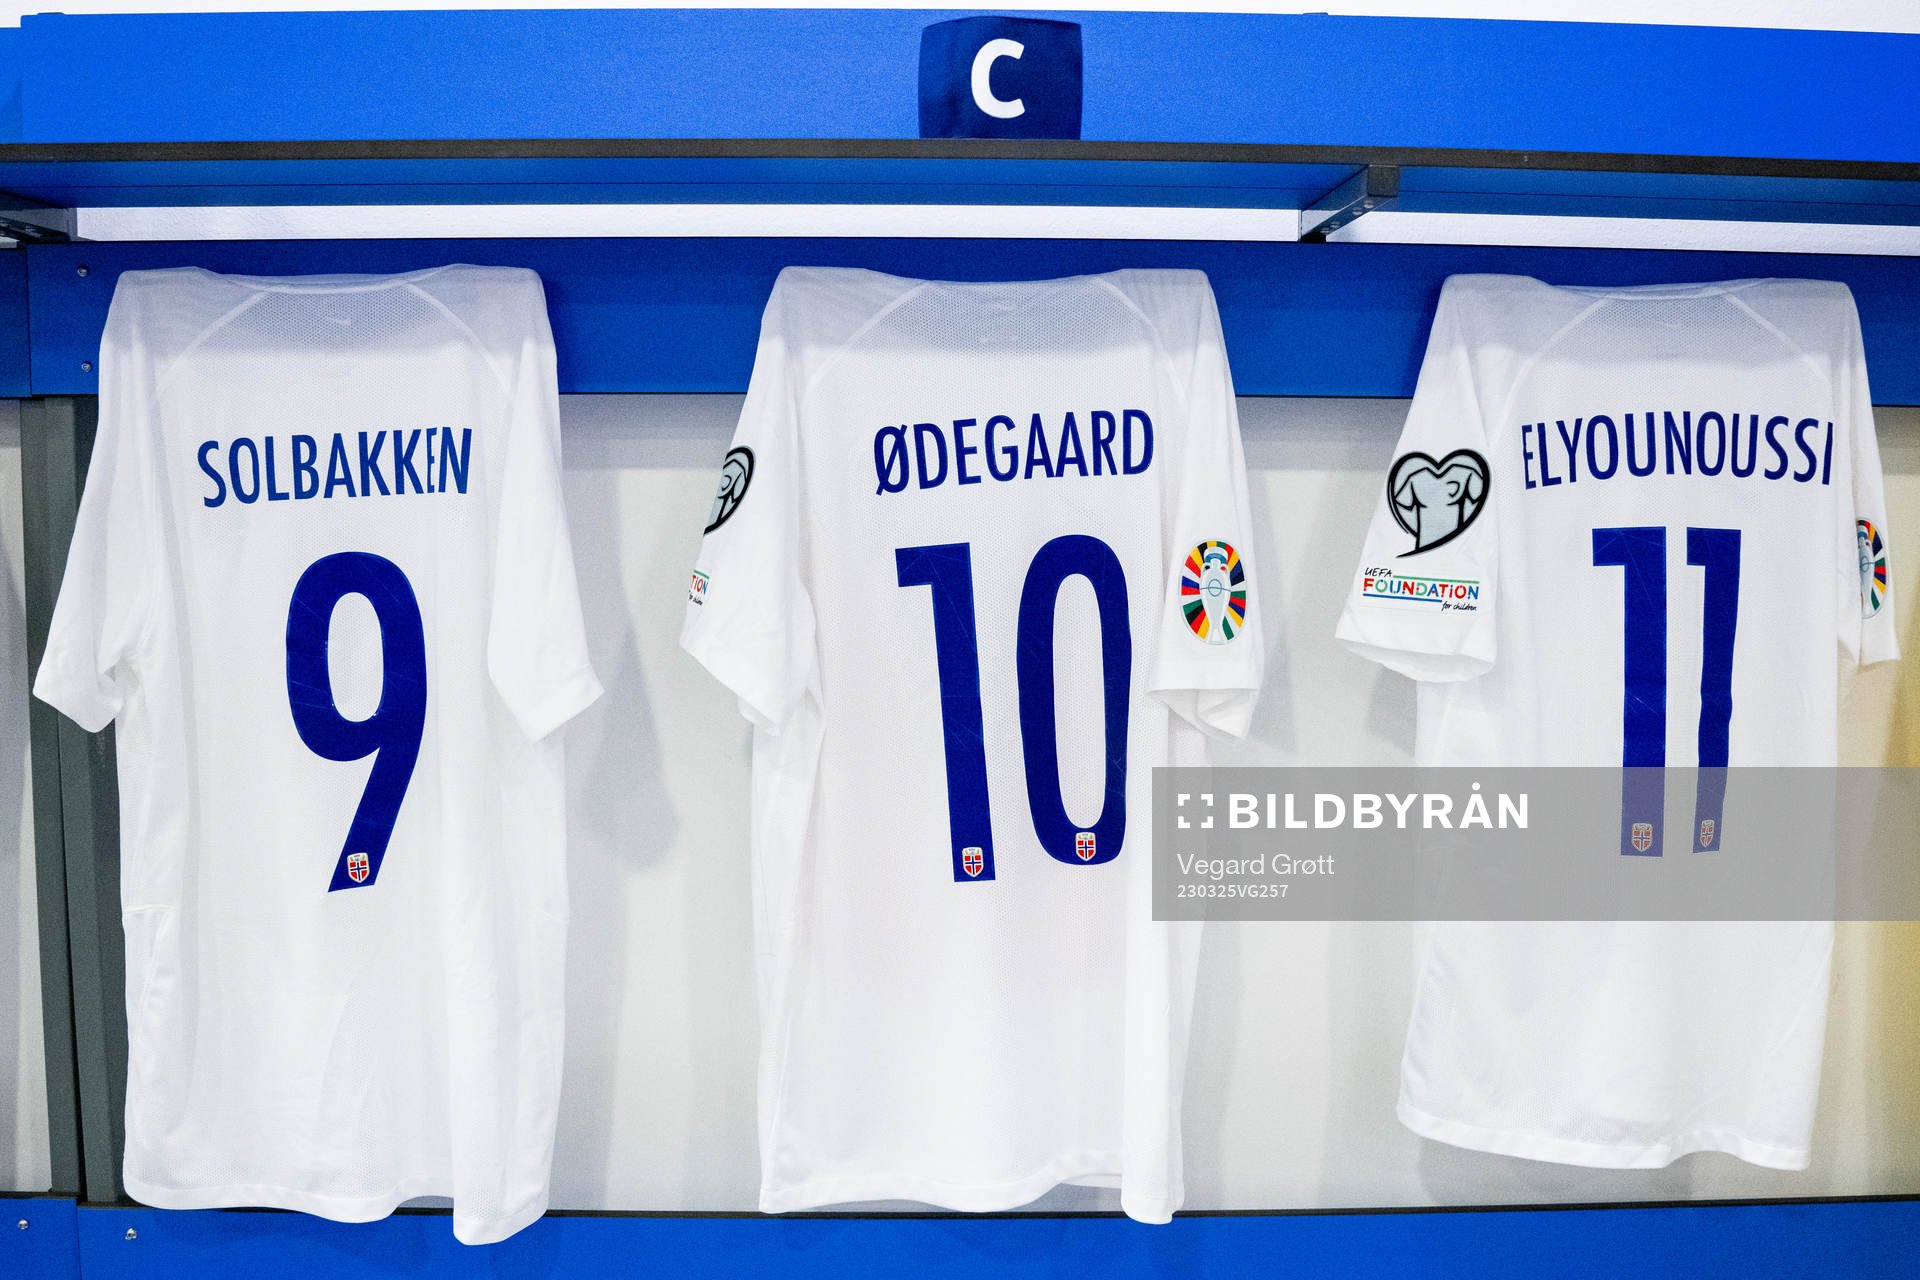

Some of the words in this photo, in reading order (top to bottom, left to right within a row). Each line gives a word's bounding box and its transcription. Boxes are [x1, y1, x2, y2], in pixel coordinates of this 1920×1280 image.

[971, 38, 1025, 119] C
[197, 426, 473, 508] SOLBAKKEN
[873, 409, 1154, 496] ØDEGAARD
[1521, 411, 1834, 490] ELYOUNOUSSI
[1364, 567, 1392, 577] UEFA
[285, 551, 428, 893] 9
[895, 534, 1133, 883] 10
[1591, 526, 1742, 858] 11
